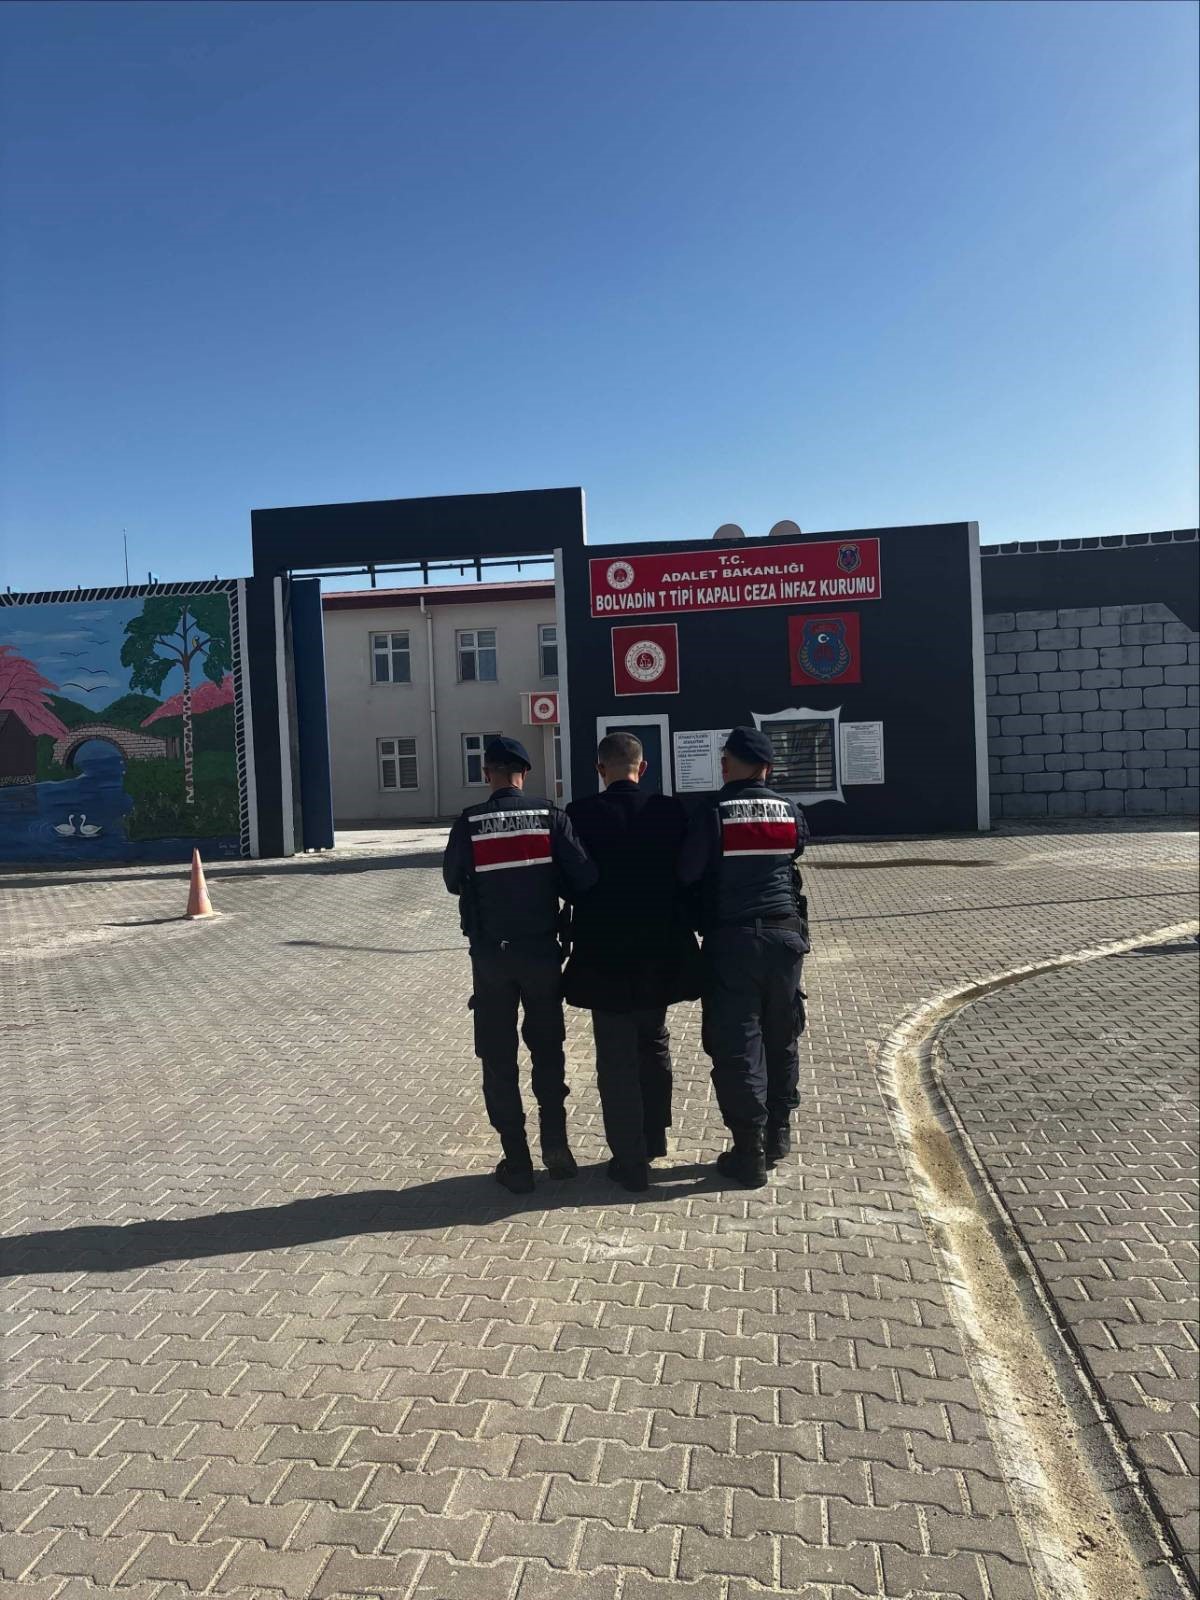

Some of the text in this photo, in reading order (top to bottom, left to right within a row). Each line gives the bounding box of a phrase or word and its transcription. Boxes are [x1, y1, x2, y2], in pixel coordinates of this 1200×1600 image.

[718, 555, 745, 565] T.C.
[661, 563, 804, 583] ADALET BAKANLIĞI
[595, 576, 875, 611] BOLVADİN T TİPİ KAPALI CEZA İNFAZ KURUMU
[728, 803, 789, 818] JANDARMA
[478, 815, 543, 834] JANDARMA
